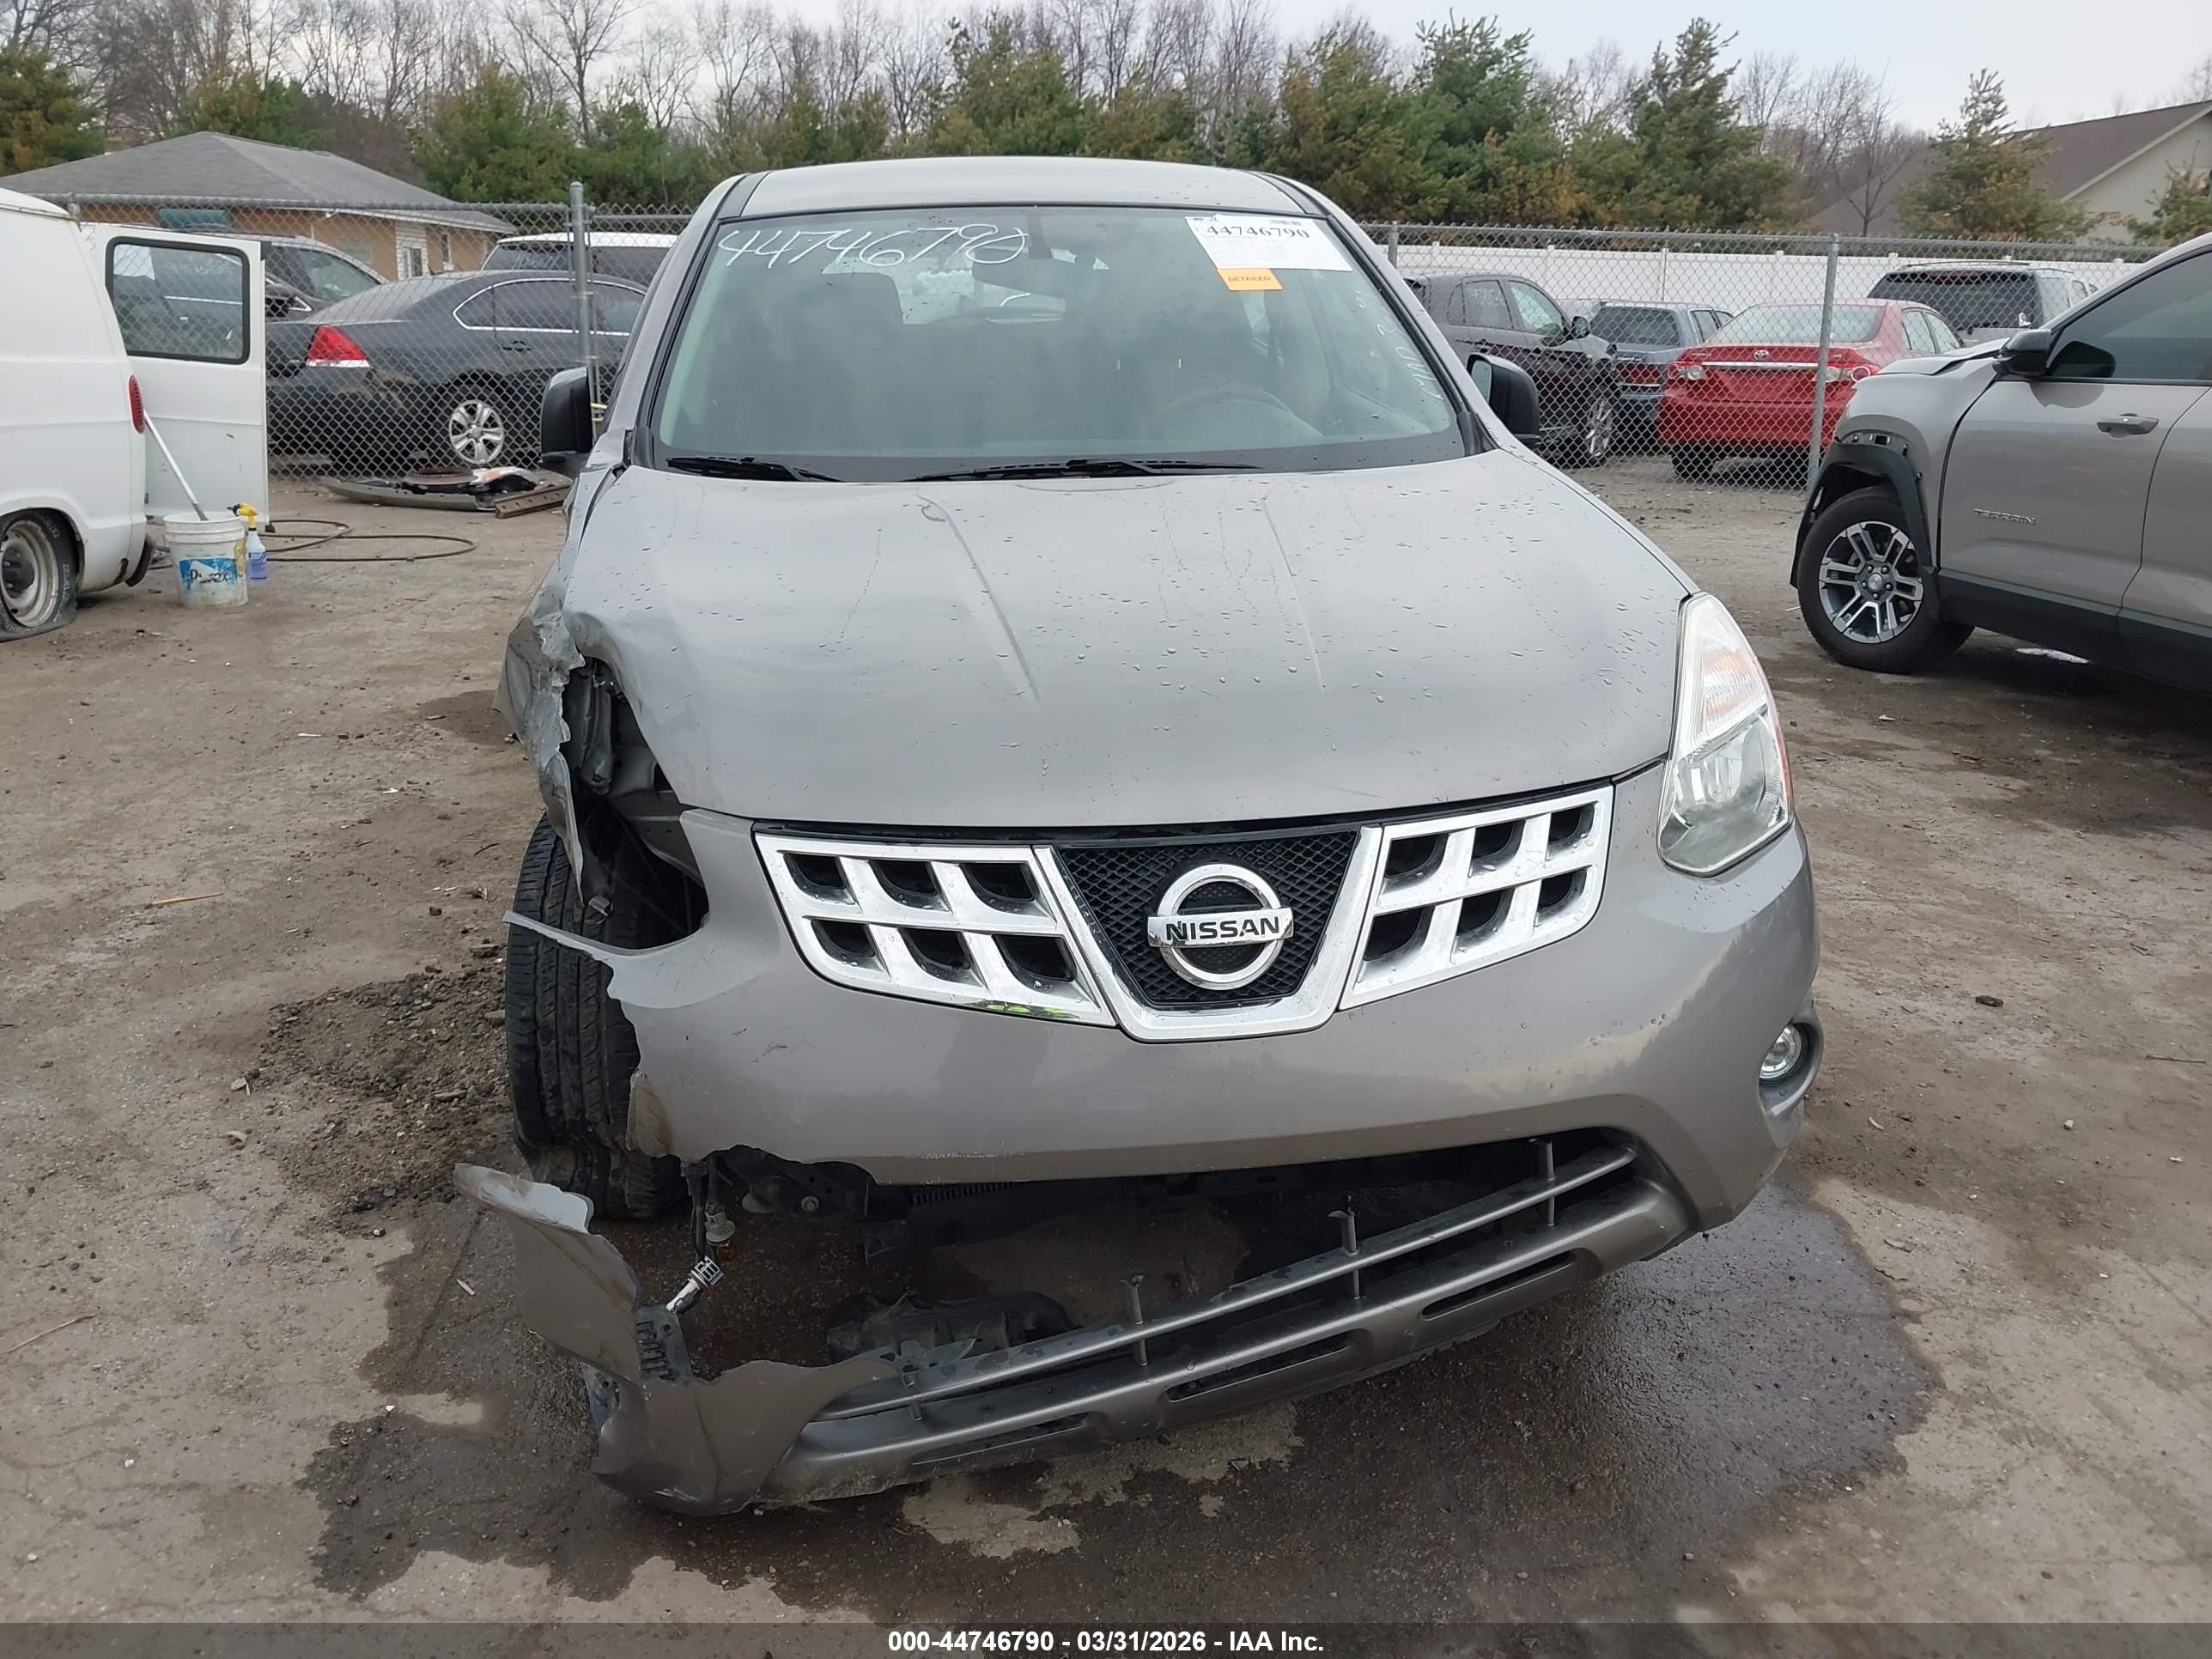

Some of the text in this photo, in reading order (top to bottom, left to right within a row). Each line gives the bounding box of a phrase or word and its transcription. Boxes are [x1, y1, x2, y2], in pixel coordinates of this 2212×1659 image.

[1206, 225, 1310, 239] 44746790
[719, 224, 1030, 269] 44746790
[1972, 508, 2036, 525] TERRAIN
[190, 568, 229, 584] Pex
[1166, 916, 1280, 942] NISSAN
